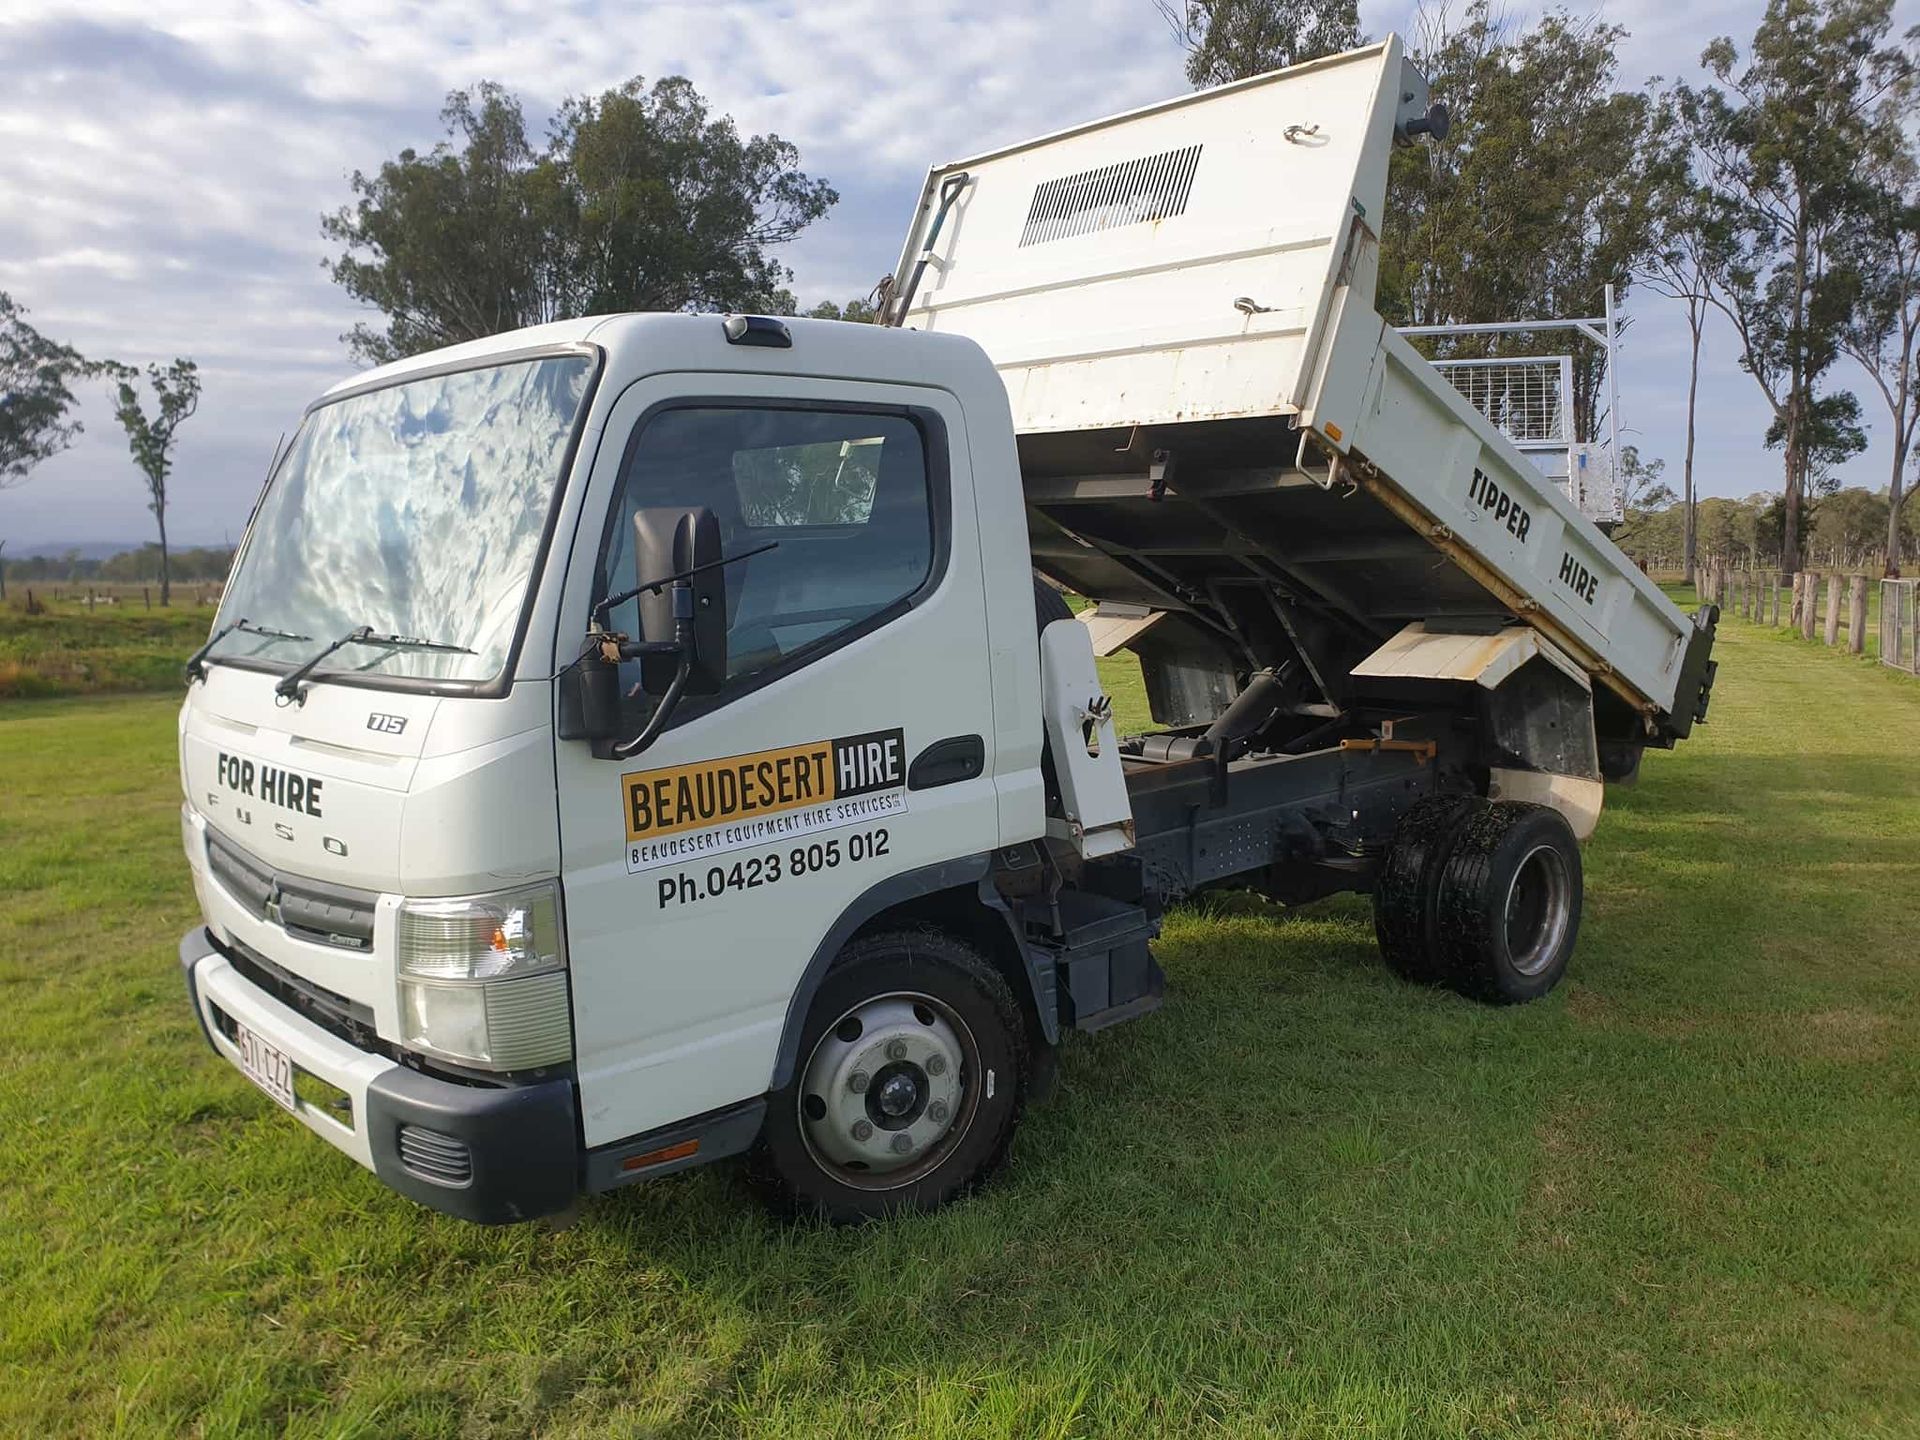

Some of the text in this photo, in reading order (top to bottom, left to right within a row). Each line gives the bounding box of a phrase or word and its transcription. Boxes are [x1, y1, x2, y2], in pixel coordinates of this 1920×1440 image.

[1469, 467, 1598, 605] TIPPER HIRE
[370, 713, 405, 733] 715
[218, 752, 323, 818] FOR HIRE
[630, 738, 900, 833] BEAUDESERT HIRE
[207, 792, 348, 857] FUSO
[632, 795, 893, 864] BEAUDESERT EQUIPMENT HIRE SERVICES
[658, 828, 890, 909] Ph.0423 805 012
